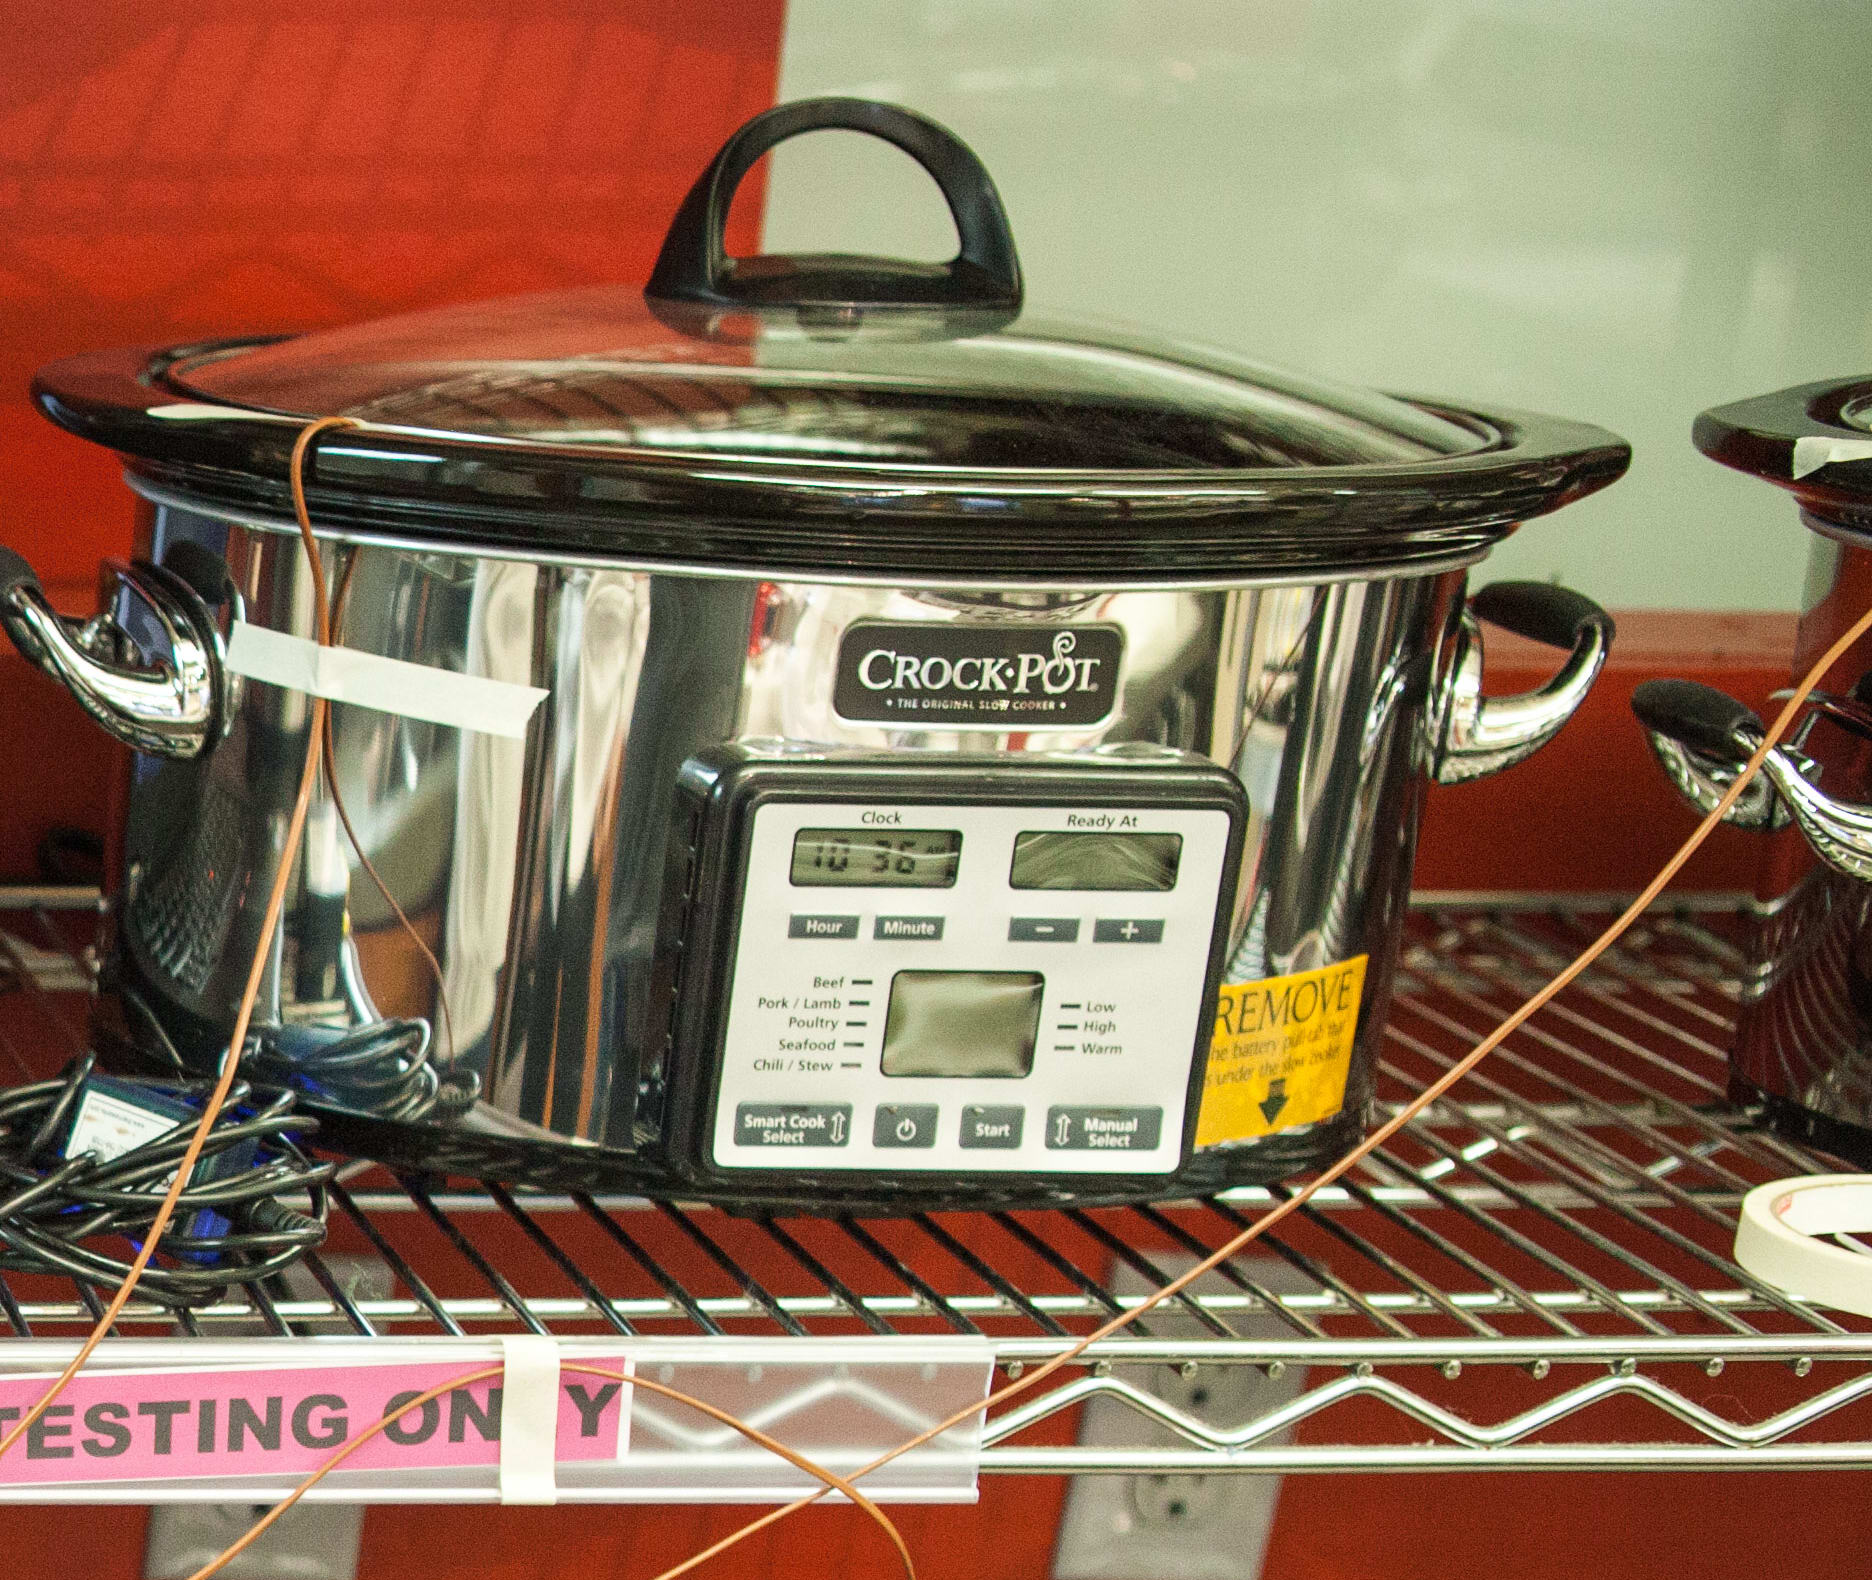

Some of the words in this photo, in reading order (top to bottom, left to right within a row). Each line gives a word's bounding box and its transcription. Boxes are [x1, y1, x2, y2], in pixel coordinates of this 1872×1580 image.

[896, 698, 918, 709] THE
[922, 698, 974, 710] ORIGINAL
[978, 699, 1010, 711] SLOW
[1012, 700, 1055, 711] COOKER
[861, 811, 902, 825] Clock
[1067, 813, 1116, 830] Ready
[1119, 814, 1138, 828] At
[805, 919, 843, 934] Hour
[883, 920, 936, 936] Minute
[813, 976, 845, 989] Beef
[758, 997, 789, 1010] Pork
[803, 997, 842, 1010] Lamb
[1086, 1001, 1117, 1014] Low
[1217, 970, 1354, 1035] REMOVE
[788, 1016, 839, 1032] Poultry
[1083, 1021, 1117, 1035] High
[778, 1038, 836, 1051] Seafood
[1081, 1043, 1123, 1056] Warm
[753, 1059, 785, 1072] Chili
[797, 1059, 834, 1072] Stew
[744, 1115, 786, 1130] Smart
[789, 1115, 826, 1130] Cook
[1083, 1118, 1138, 1134] Manual
[762, 1130, 805, 1145] Select
[975, 1123, 1010, 1138] Start
[1088, 1134, 1131, 1148] Select
[384, 1383, 623, 1448] ONY
